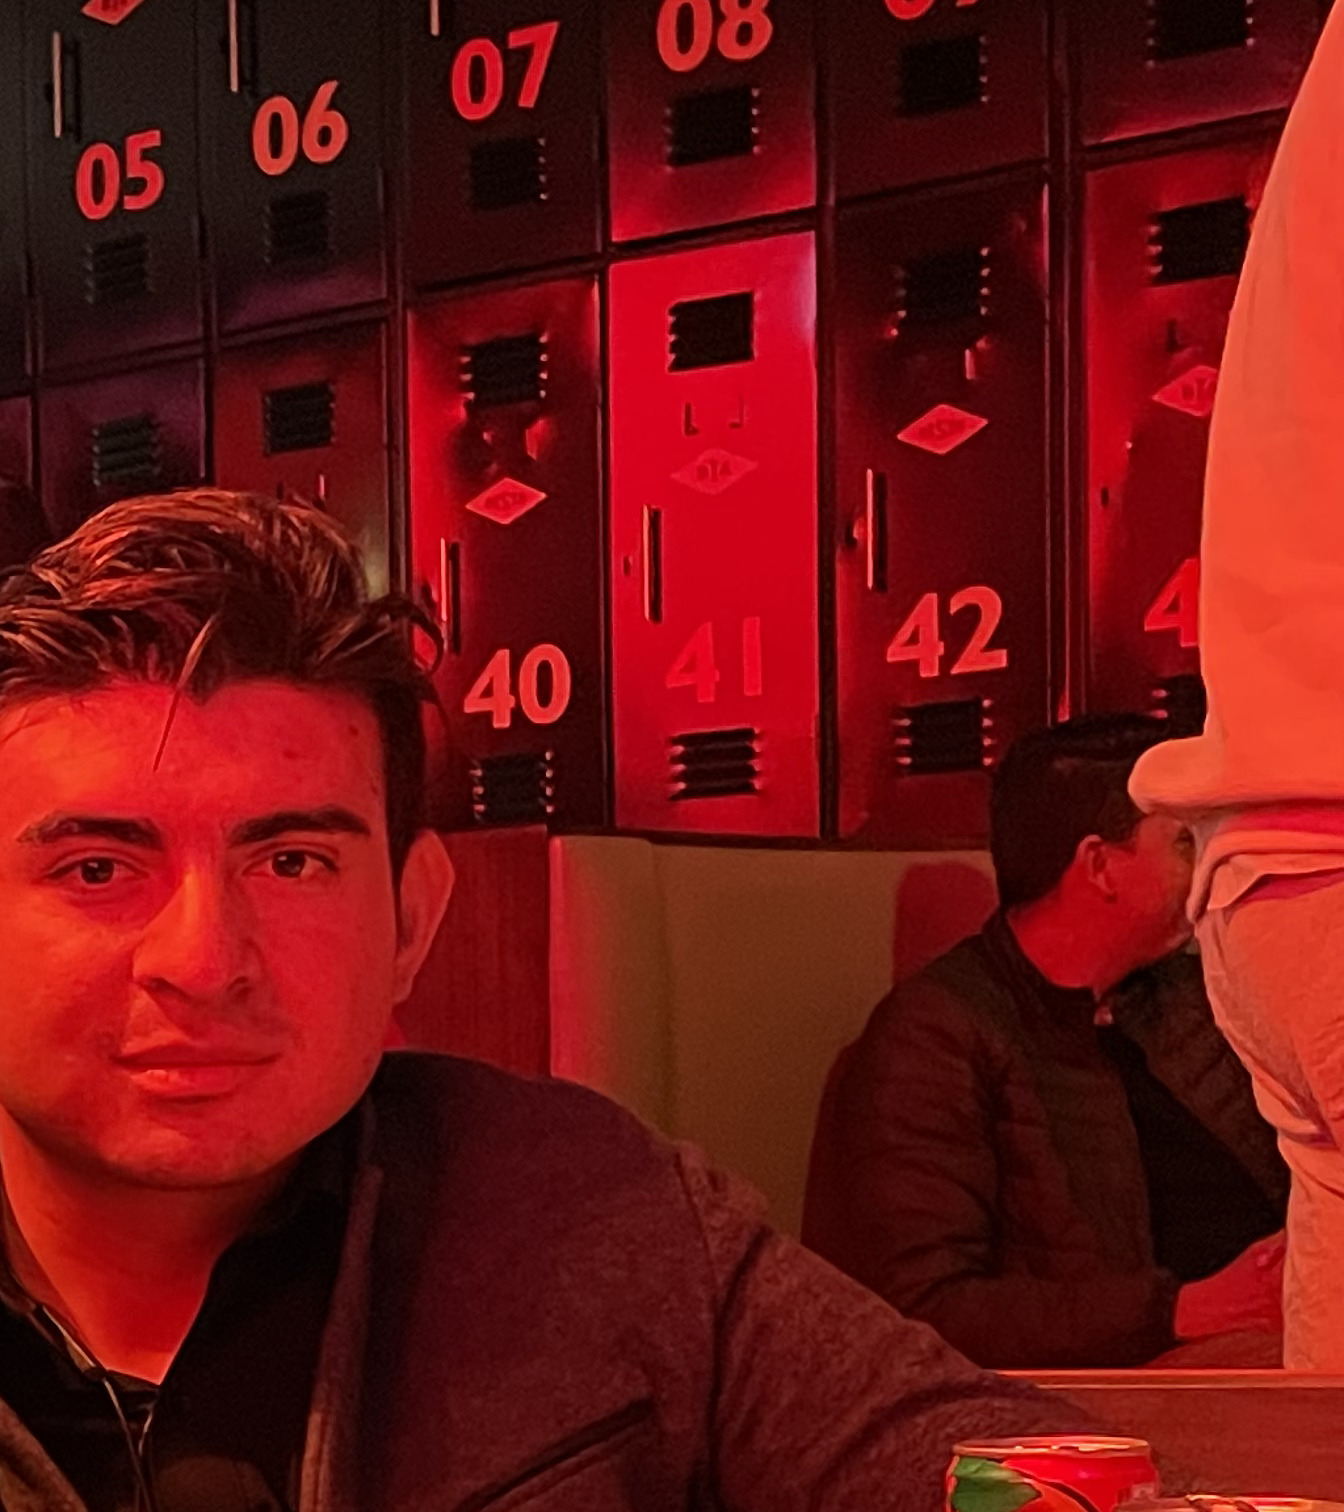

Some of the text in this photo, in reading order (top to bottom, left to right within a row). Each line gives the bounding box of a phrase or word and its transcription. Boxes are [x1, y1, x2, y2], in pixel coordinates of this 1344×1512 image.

[450, 21, 560, 121] 07
[657, 0, 774, 72] 08
[251, 80, 349, 177] 06
[74, 129, 166, 220] 05
[887, 586, 1009, 677] 42
[1144, 558, 1201, 648] 4
[464, 643, 572, 730] 40
[665, 616, 763, 703] 41
